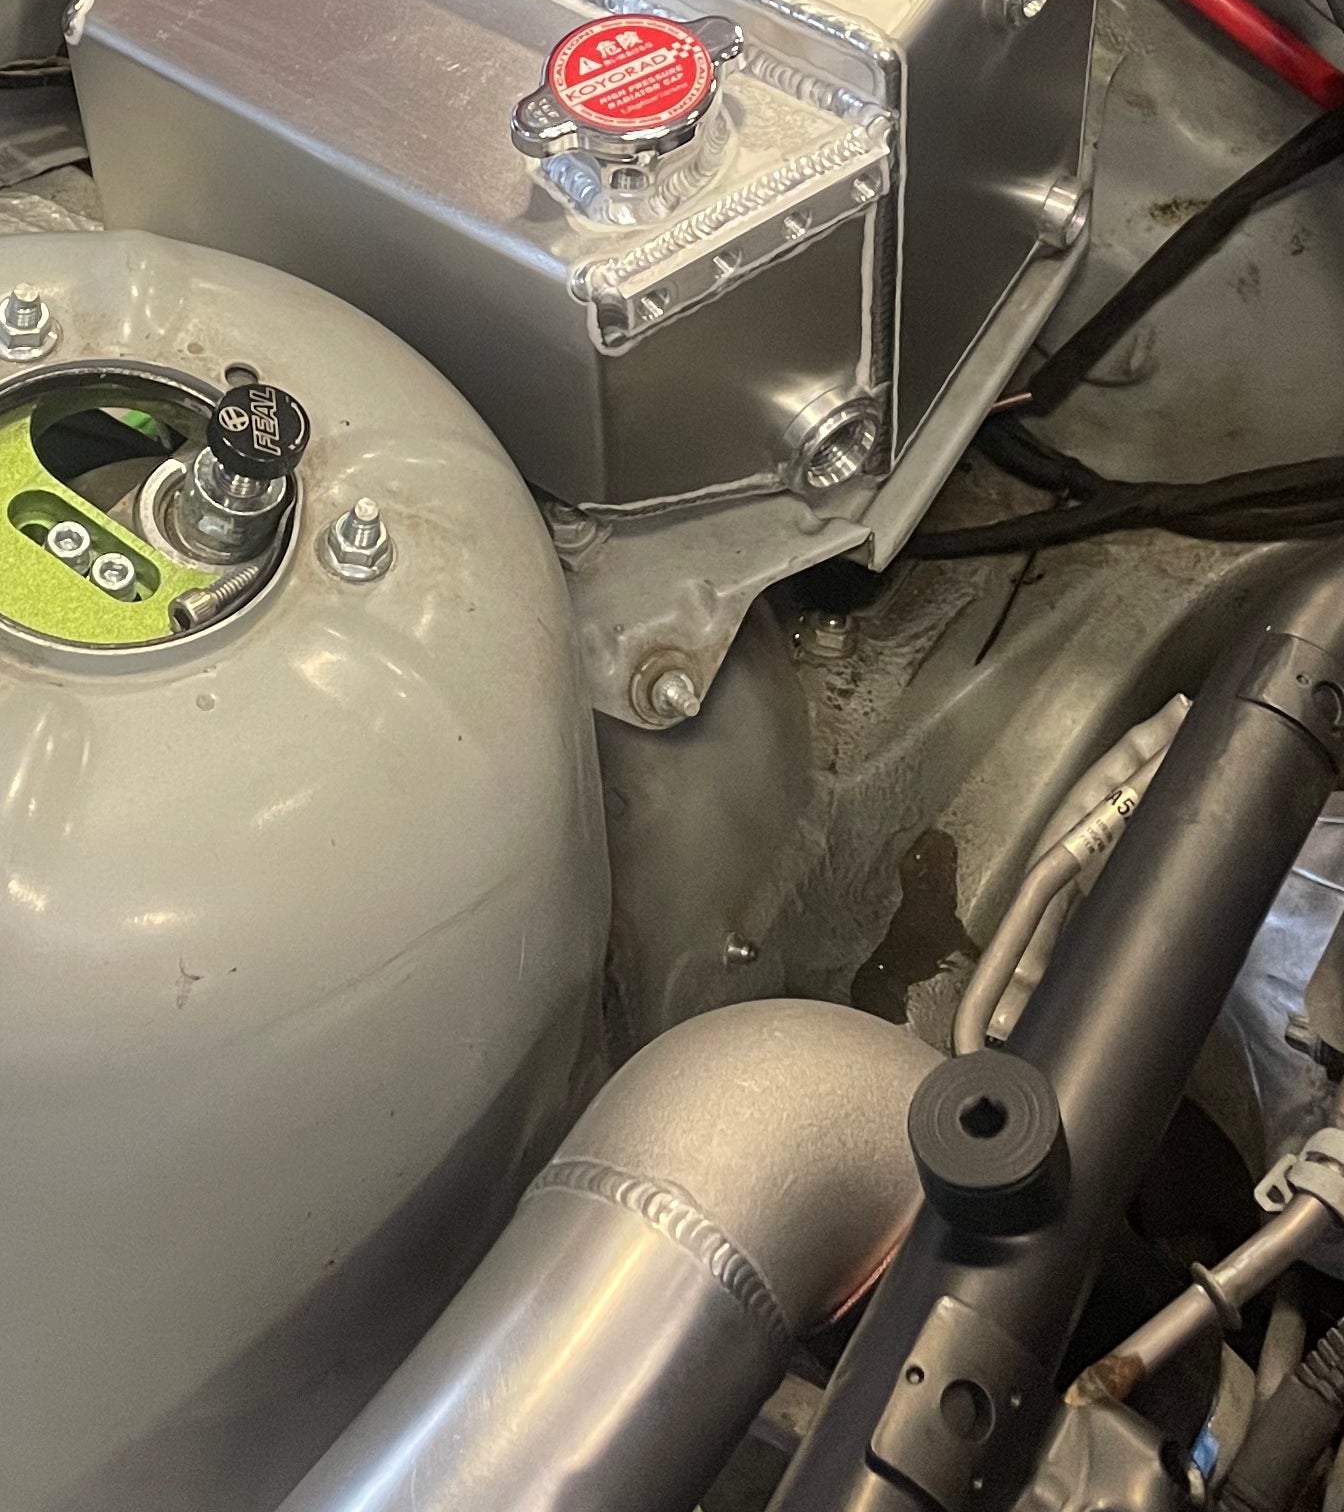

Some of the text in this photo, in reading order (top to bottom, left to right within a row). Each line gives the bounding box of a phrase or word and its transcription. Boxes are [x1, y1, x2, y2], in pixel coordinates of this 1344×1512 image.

[565, 52, 668, 103] KOYORAD
[607, 83, 661, 110] RADIATOR
[662, 73, 684, 86] CAP
[628, 64, 683, 93] PRESSURE
[249, 387, 282, 456] FEAL
